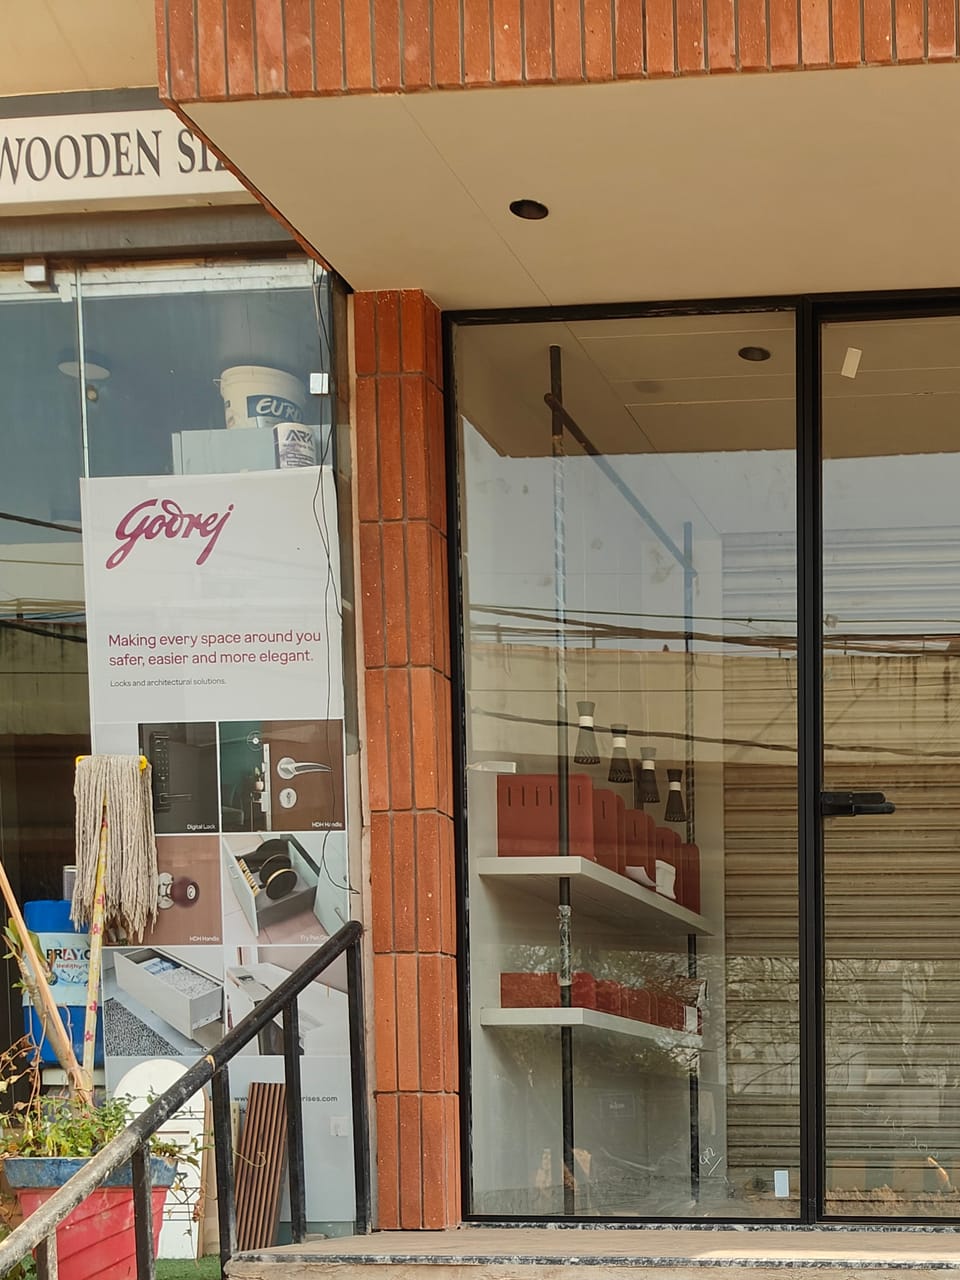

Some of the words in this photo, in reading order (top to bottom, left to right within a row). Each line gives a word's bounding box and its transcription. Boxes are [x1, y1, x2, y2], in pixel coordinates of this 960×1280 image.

[0, 128, 162, 185] WOODEN
[177, 128, 229, 175] SI
[105, 498, 235, 570] Godrej
[108, 633, 157, 649] Making
[159, 634, 198, 648] every
[200, 632, 241, 647] space
[244, 630, 293, 645] around
[295, 631, 321, 645] you
[109, 653, 145, 667] safer,
[148, 652, 188, 665] easier
[192, 651, 217, 664] and
[220, 652, 256, 663] more
[259, 649, 314, 665] elegant.
[110, 680, 131, 688] Locks
[132, 679, 146, 687] and
[146, 677, 193, 687] architectural
